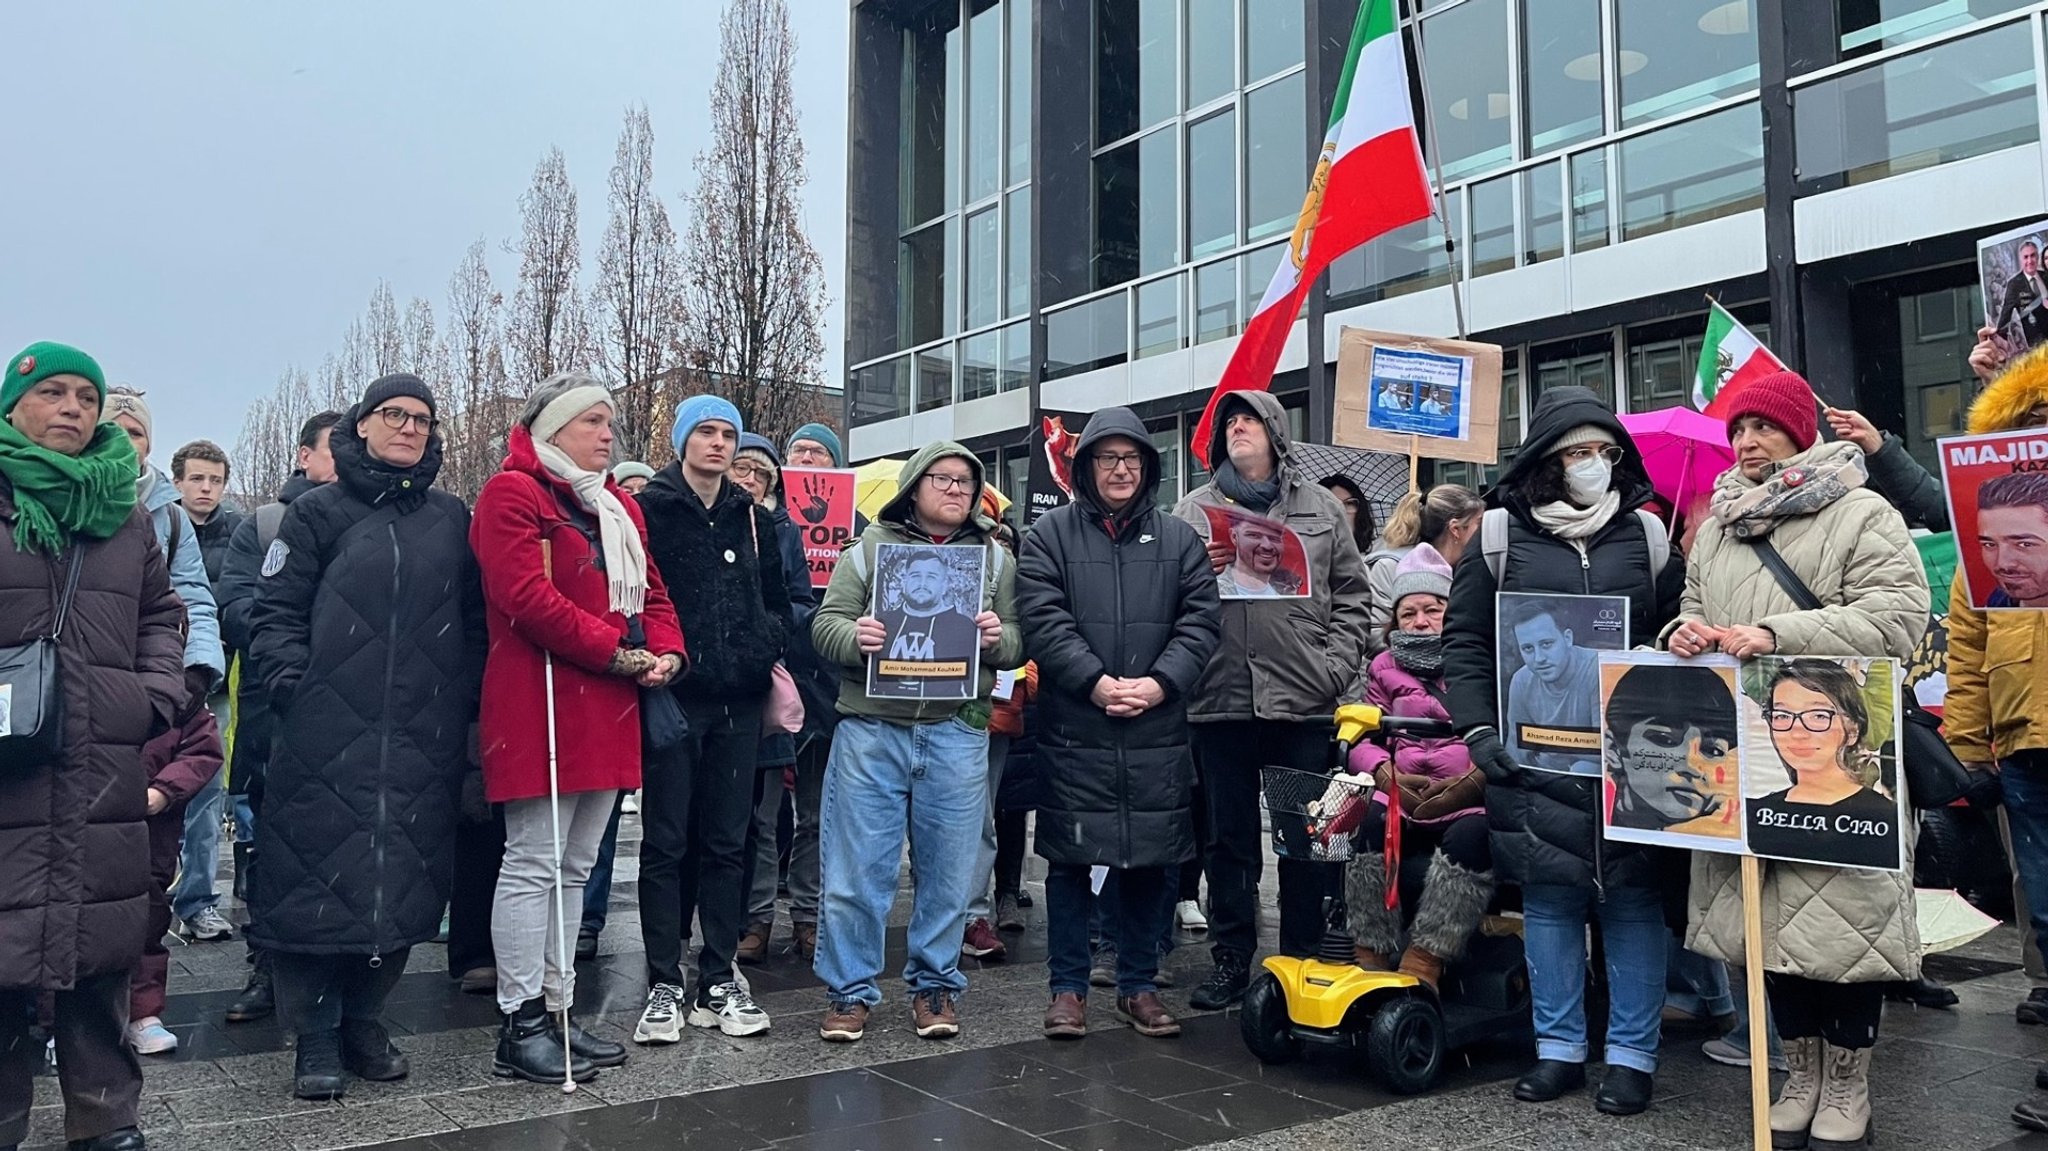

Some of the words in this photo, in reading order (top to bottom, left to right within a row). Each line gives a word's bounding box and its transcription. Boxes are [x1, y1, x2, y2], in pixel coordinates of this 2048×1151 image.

[1950, 439, 2048, 467] MAJID
[1032, 493, 1058, 505] IRAN
[799, 525, 849, 546] TOP
[1555, 735, 1572, 743] Reza
[1756, 808, 1828, 831] BELLA
[1834, 815, 1889, 837] CIAO
